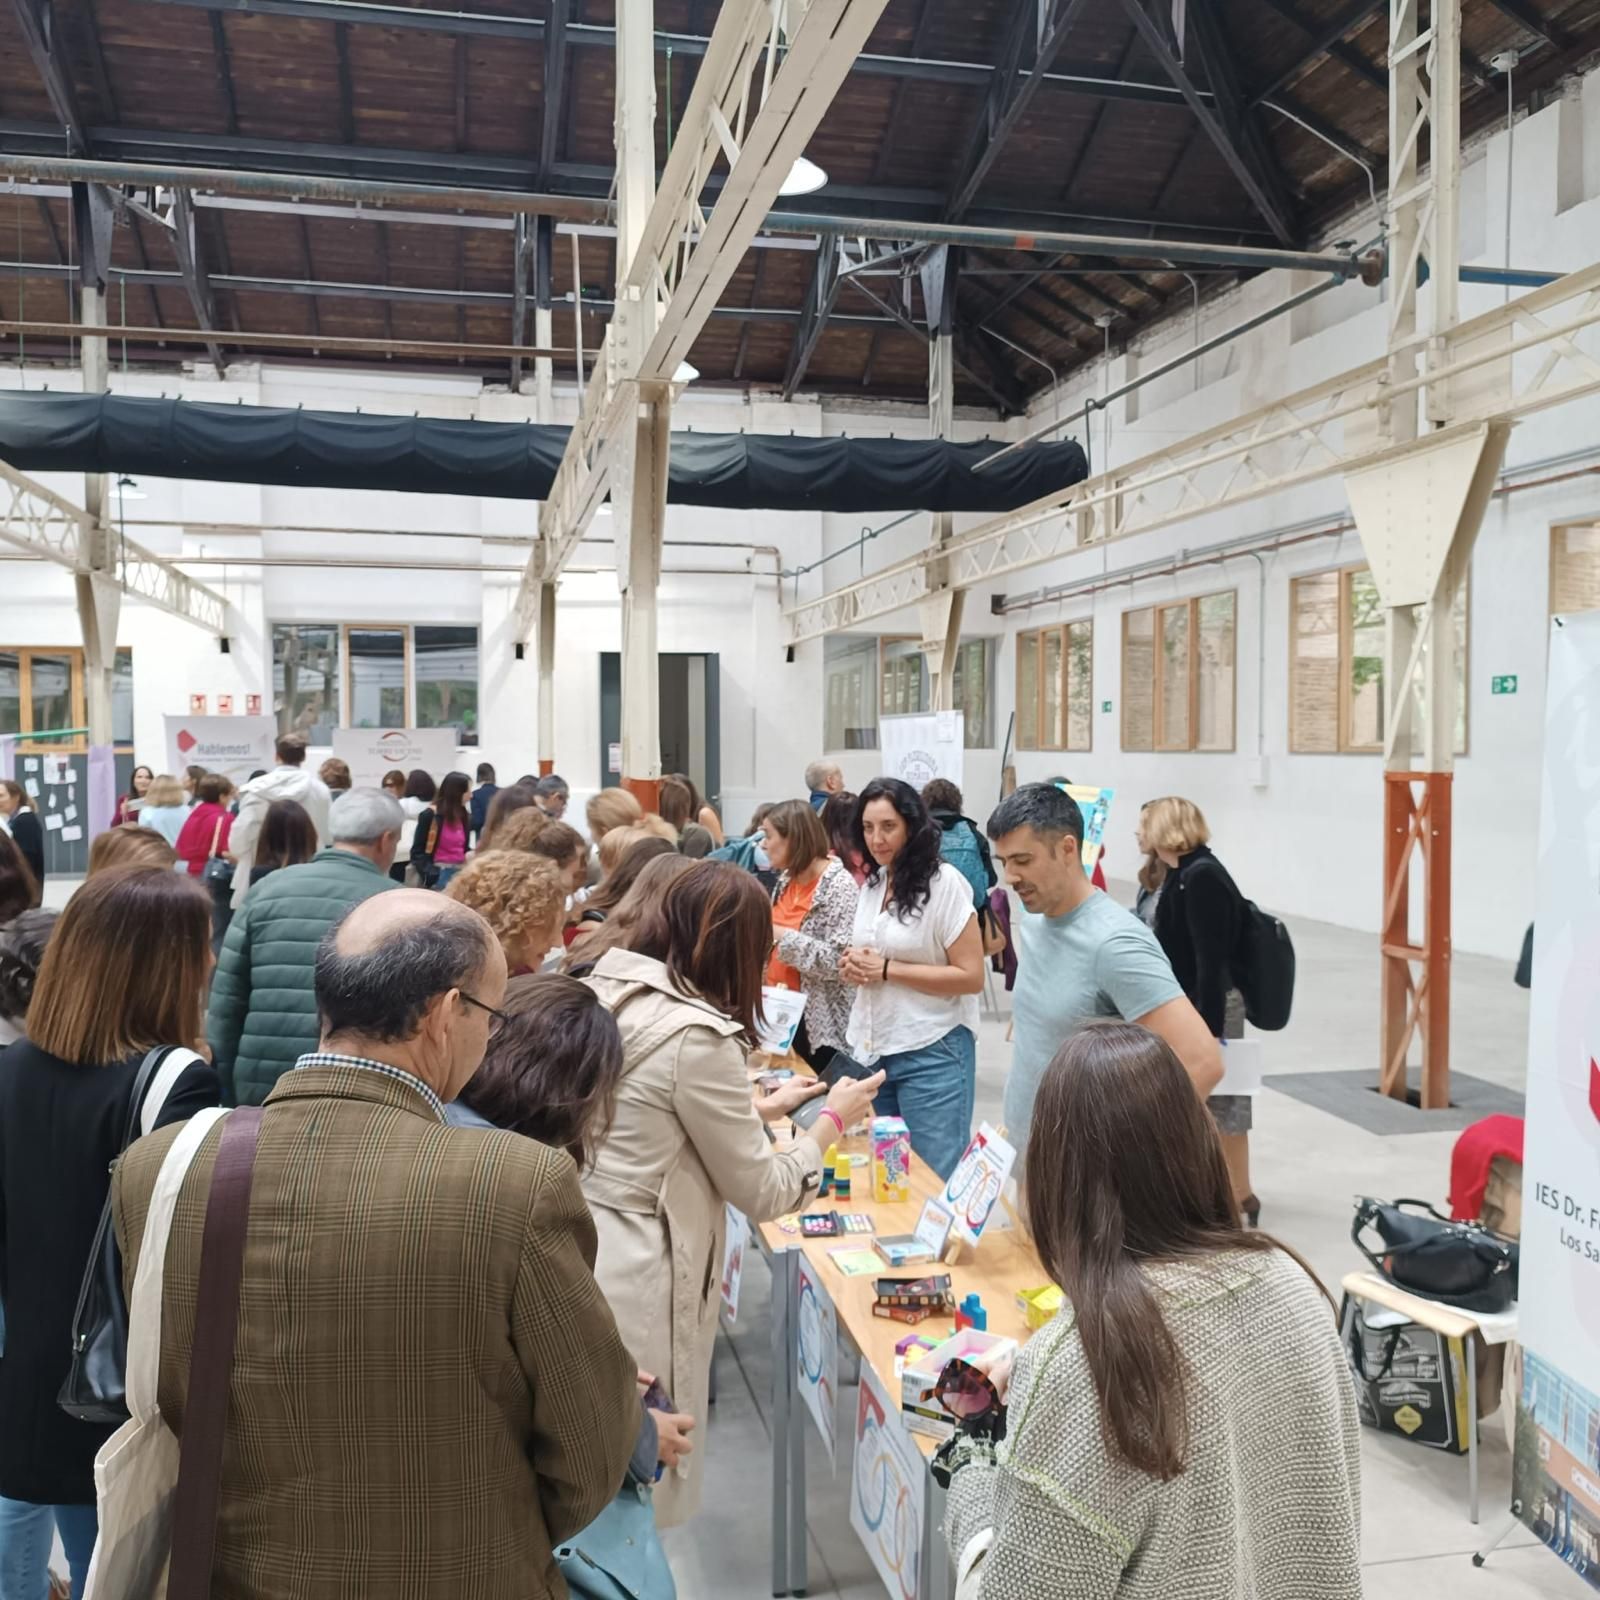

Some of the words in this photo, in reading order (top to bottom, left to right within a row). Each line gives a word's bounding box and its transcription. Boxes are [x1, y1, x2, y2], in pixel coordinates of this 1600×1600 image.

[1536, 1182, 1559, 1210] IES
[1564, 1195, 1585, 1224] Dr.
[1590, 1208, 1600, 1232] F
[1560, 1227, 1581, 1253] Los
[1585, 1240, 1600, 1263] Sa
